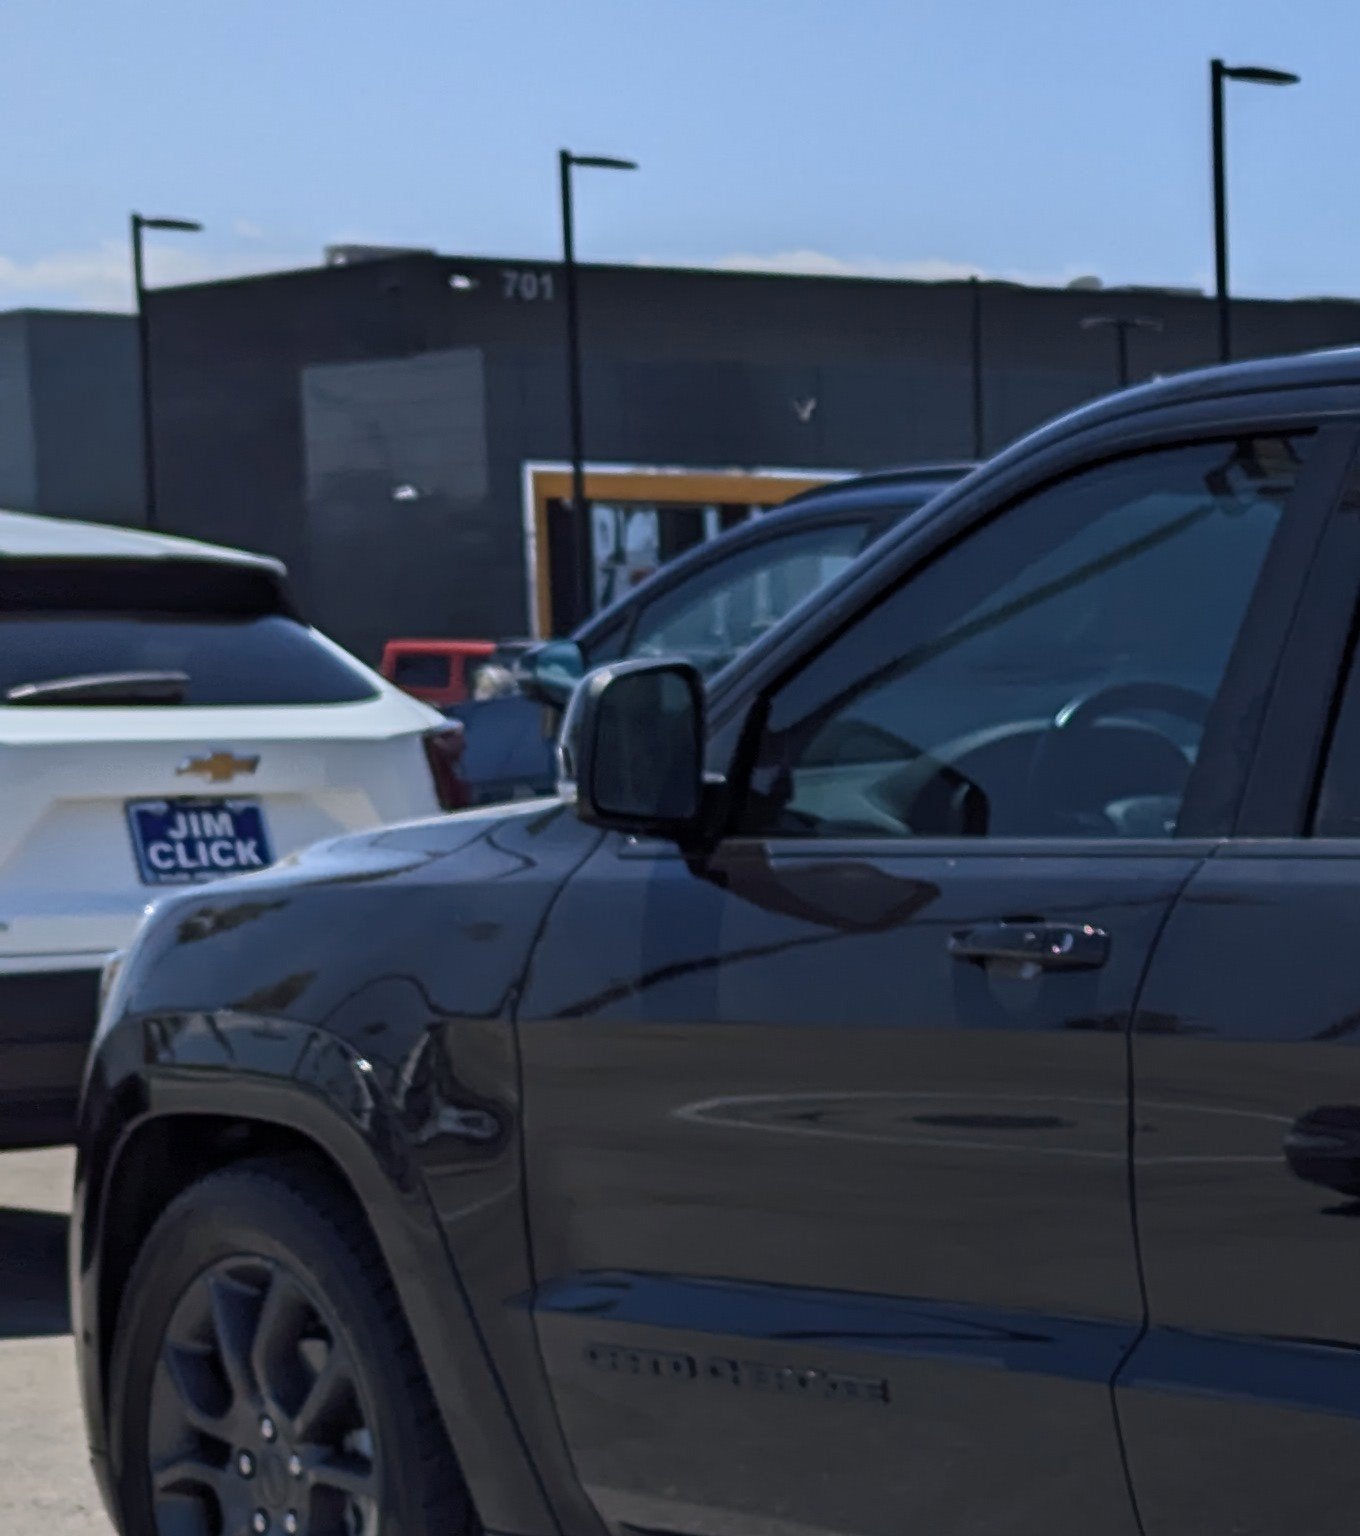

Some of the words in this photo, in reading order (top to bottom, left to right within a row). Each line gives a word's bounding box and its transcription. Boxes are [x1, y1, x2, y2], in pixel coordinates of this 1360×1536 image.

[500, 271, 554, 300] 701
[167, 811, 235, 839] JIM
[148, 838, 263, 869] CLICK
